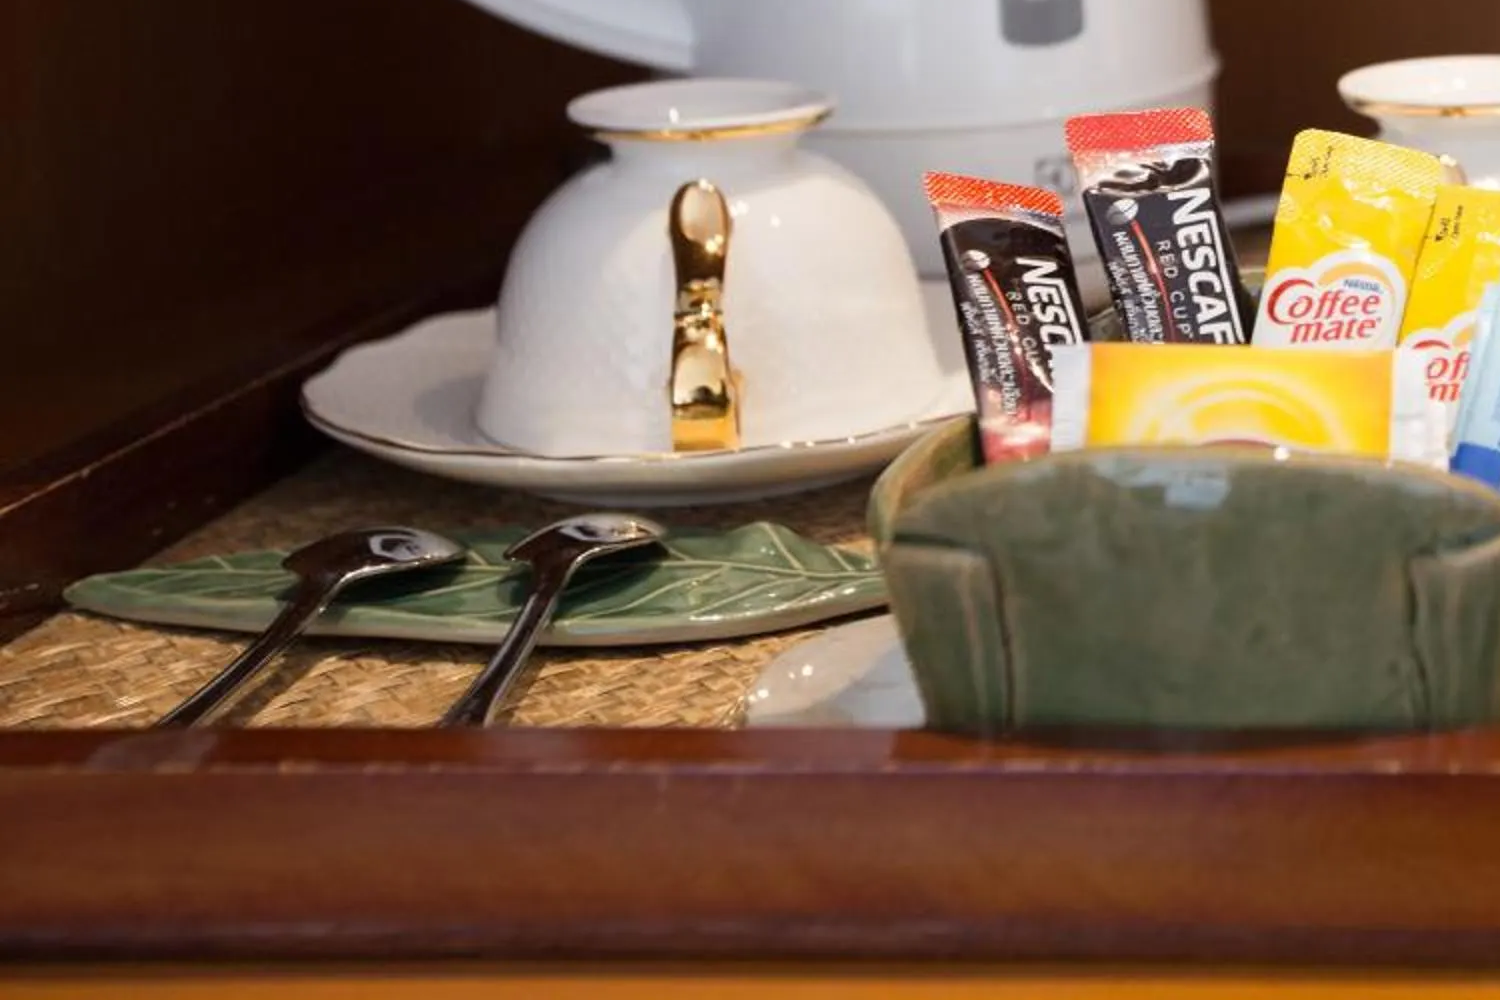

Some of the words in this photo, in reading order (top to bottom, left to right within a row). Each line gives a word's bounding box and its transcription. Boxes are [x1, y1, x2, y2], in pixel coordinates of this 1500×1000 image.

[1015, 257, 1083, 346] NESC
[1155, 239, 1179, 280] RED
[1169, 290, 1191, 335] CUP
[1167, 187, 1246, 343] NESCAF
[1267, 278, 1381, 325] Coffee
[1005, 291, 1030, 326] RED
[1019, 336, 1039, 366] CU
[1289, 315, 1377, 343] mate
